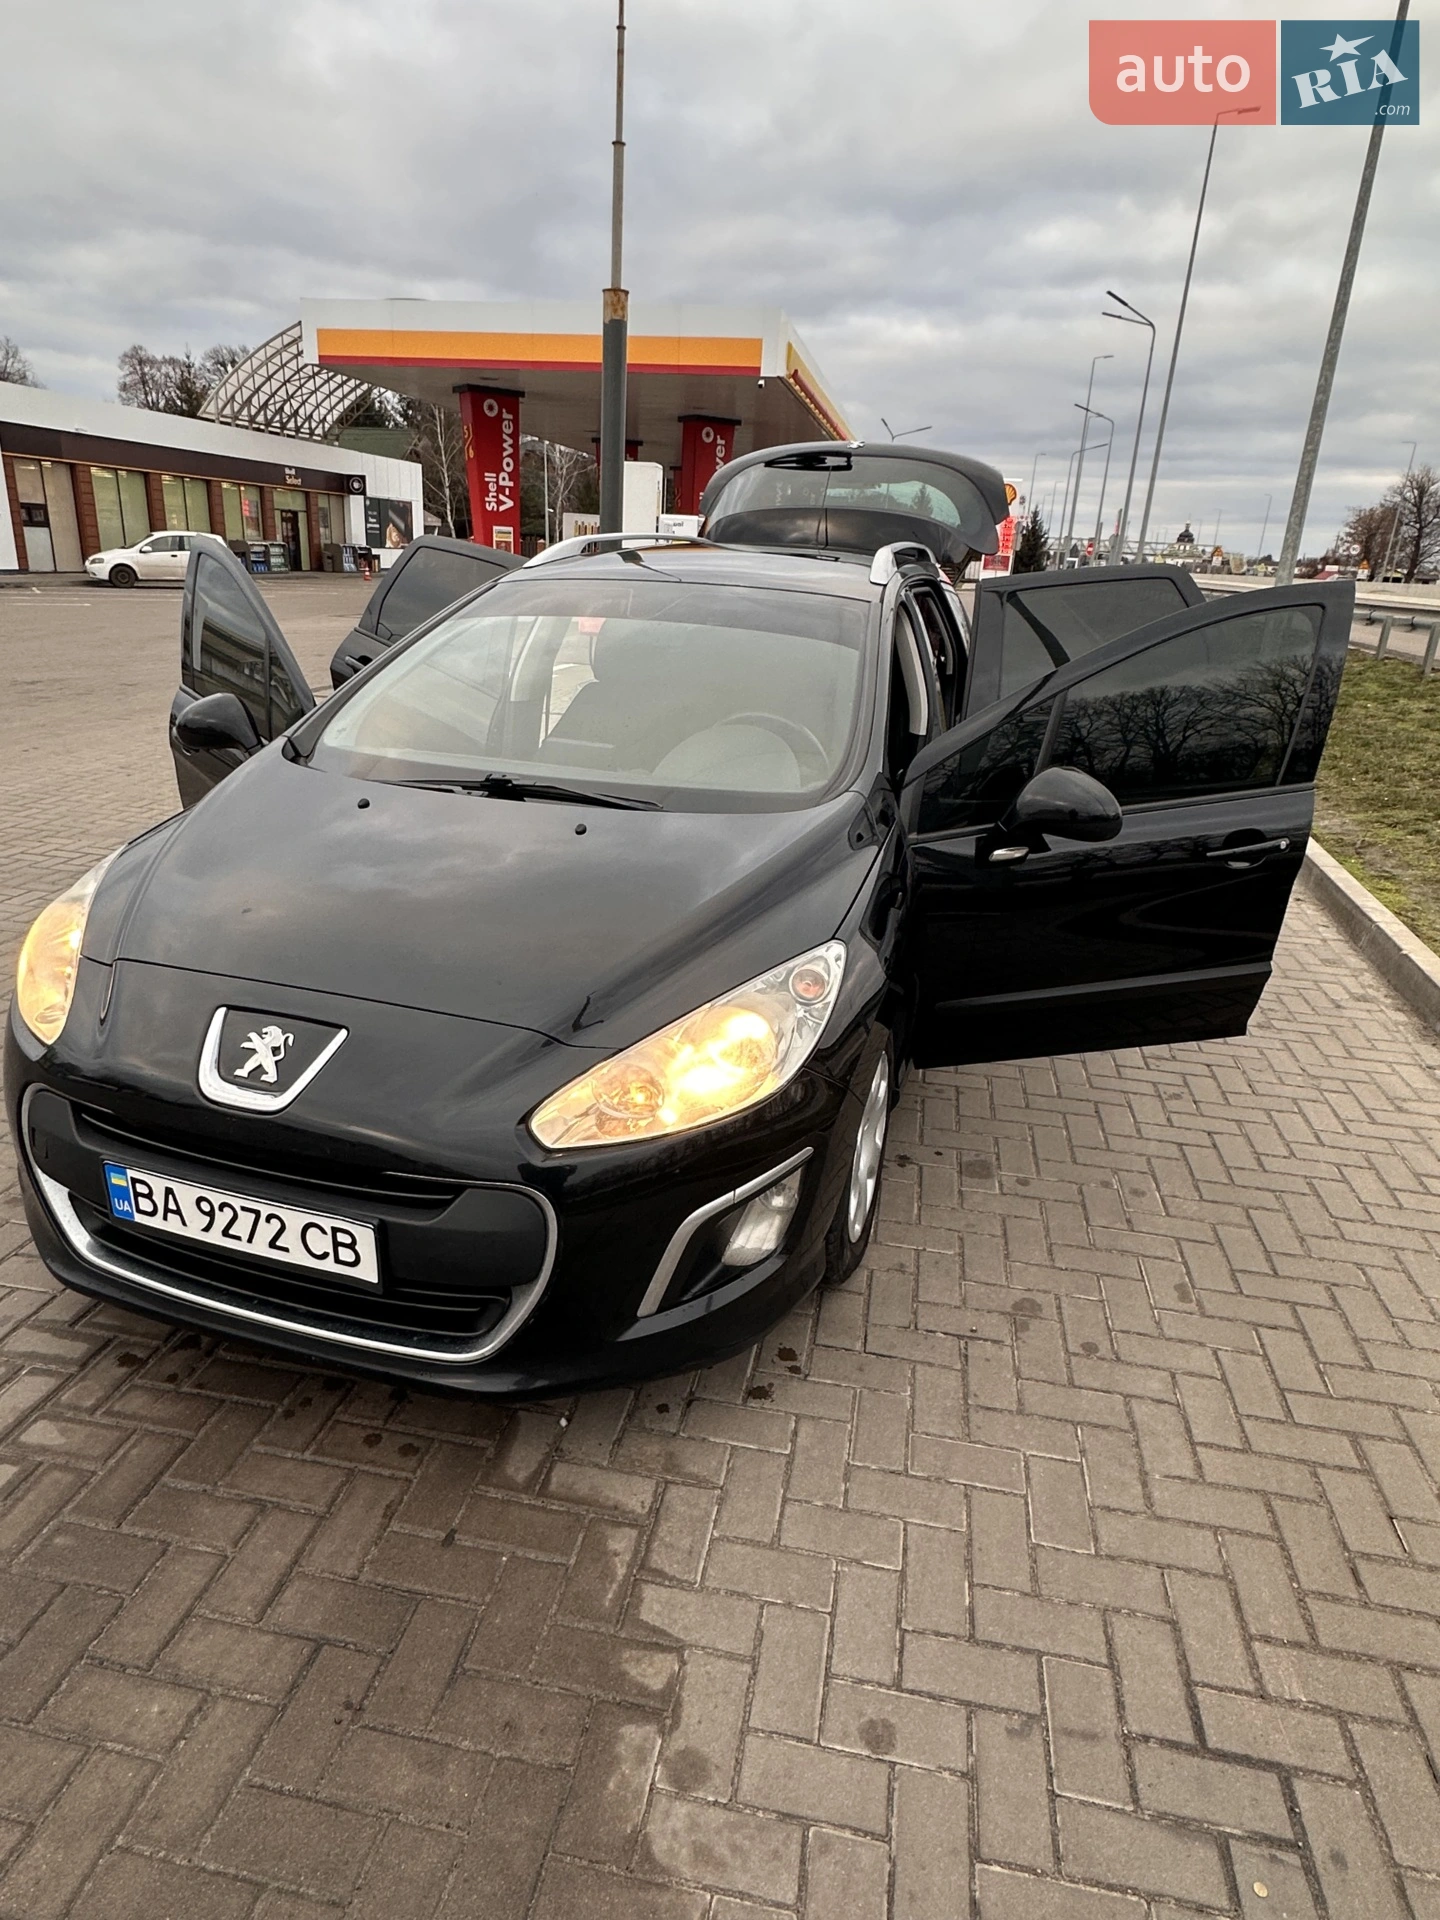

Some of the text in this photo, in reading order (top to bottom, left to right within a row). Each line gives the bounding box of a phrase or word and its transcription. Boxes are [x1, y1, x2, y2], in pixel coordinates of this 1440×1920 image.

[484, 472, 497, 512] Shell
[498, 408, 514, 513] V-Power
[114, 1197, 132, 1214] UA
[130, 1176, 362, 1269] BA 9272 CB
